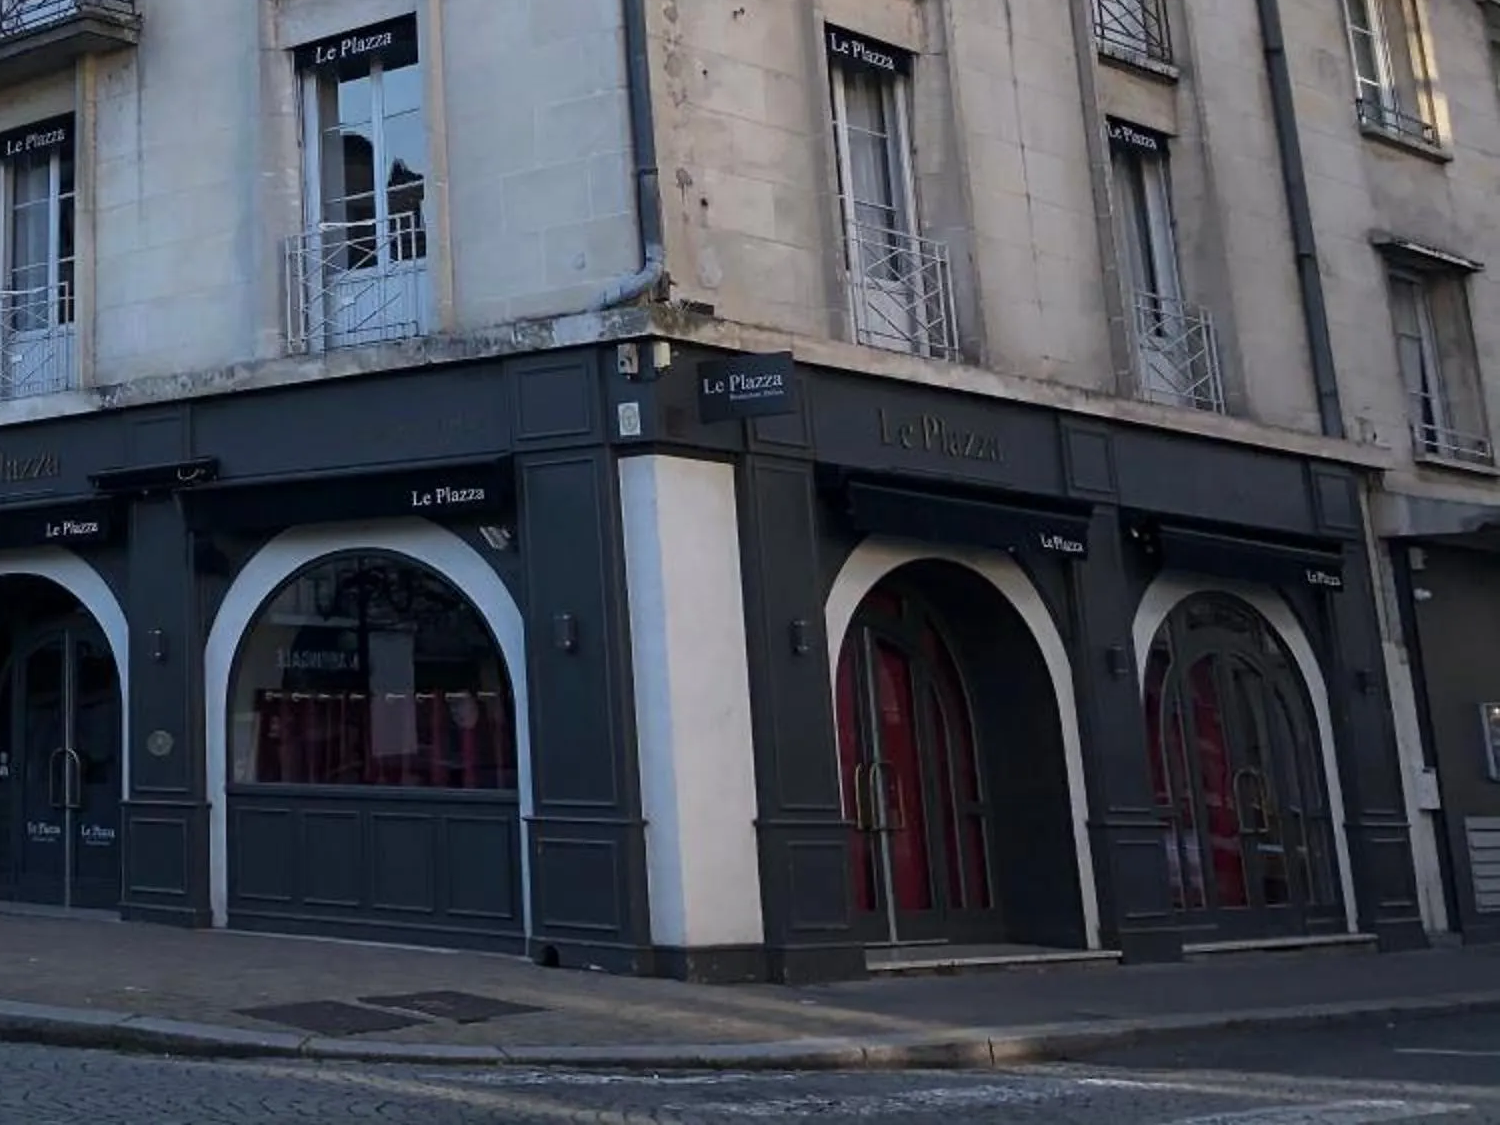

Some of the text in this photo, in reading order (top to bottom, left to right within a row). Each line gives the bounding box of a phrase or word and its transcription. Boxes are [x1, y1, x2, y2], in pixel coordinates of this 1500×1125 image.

[315, 32, 393, 64] Le Plazza
[829, 32, 895, 70] Le Plazza
[5, 127, 66, 156] Le Plazza
[703, 374, 784, 395] Le Plazza
[878, 406, 1006, 463] Le Plazza
[411, 485, 486, 507] Le Plazza
[45, 520, 99, 538] Le Plazza
[1039, 532, 1054, 549] Le
